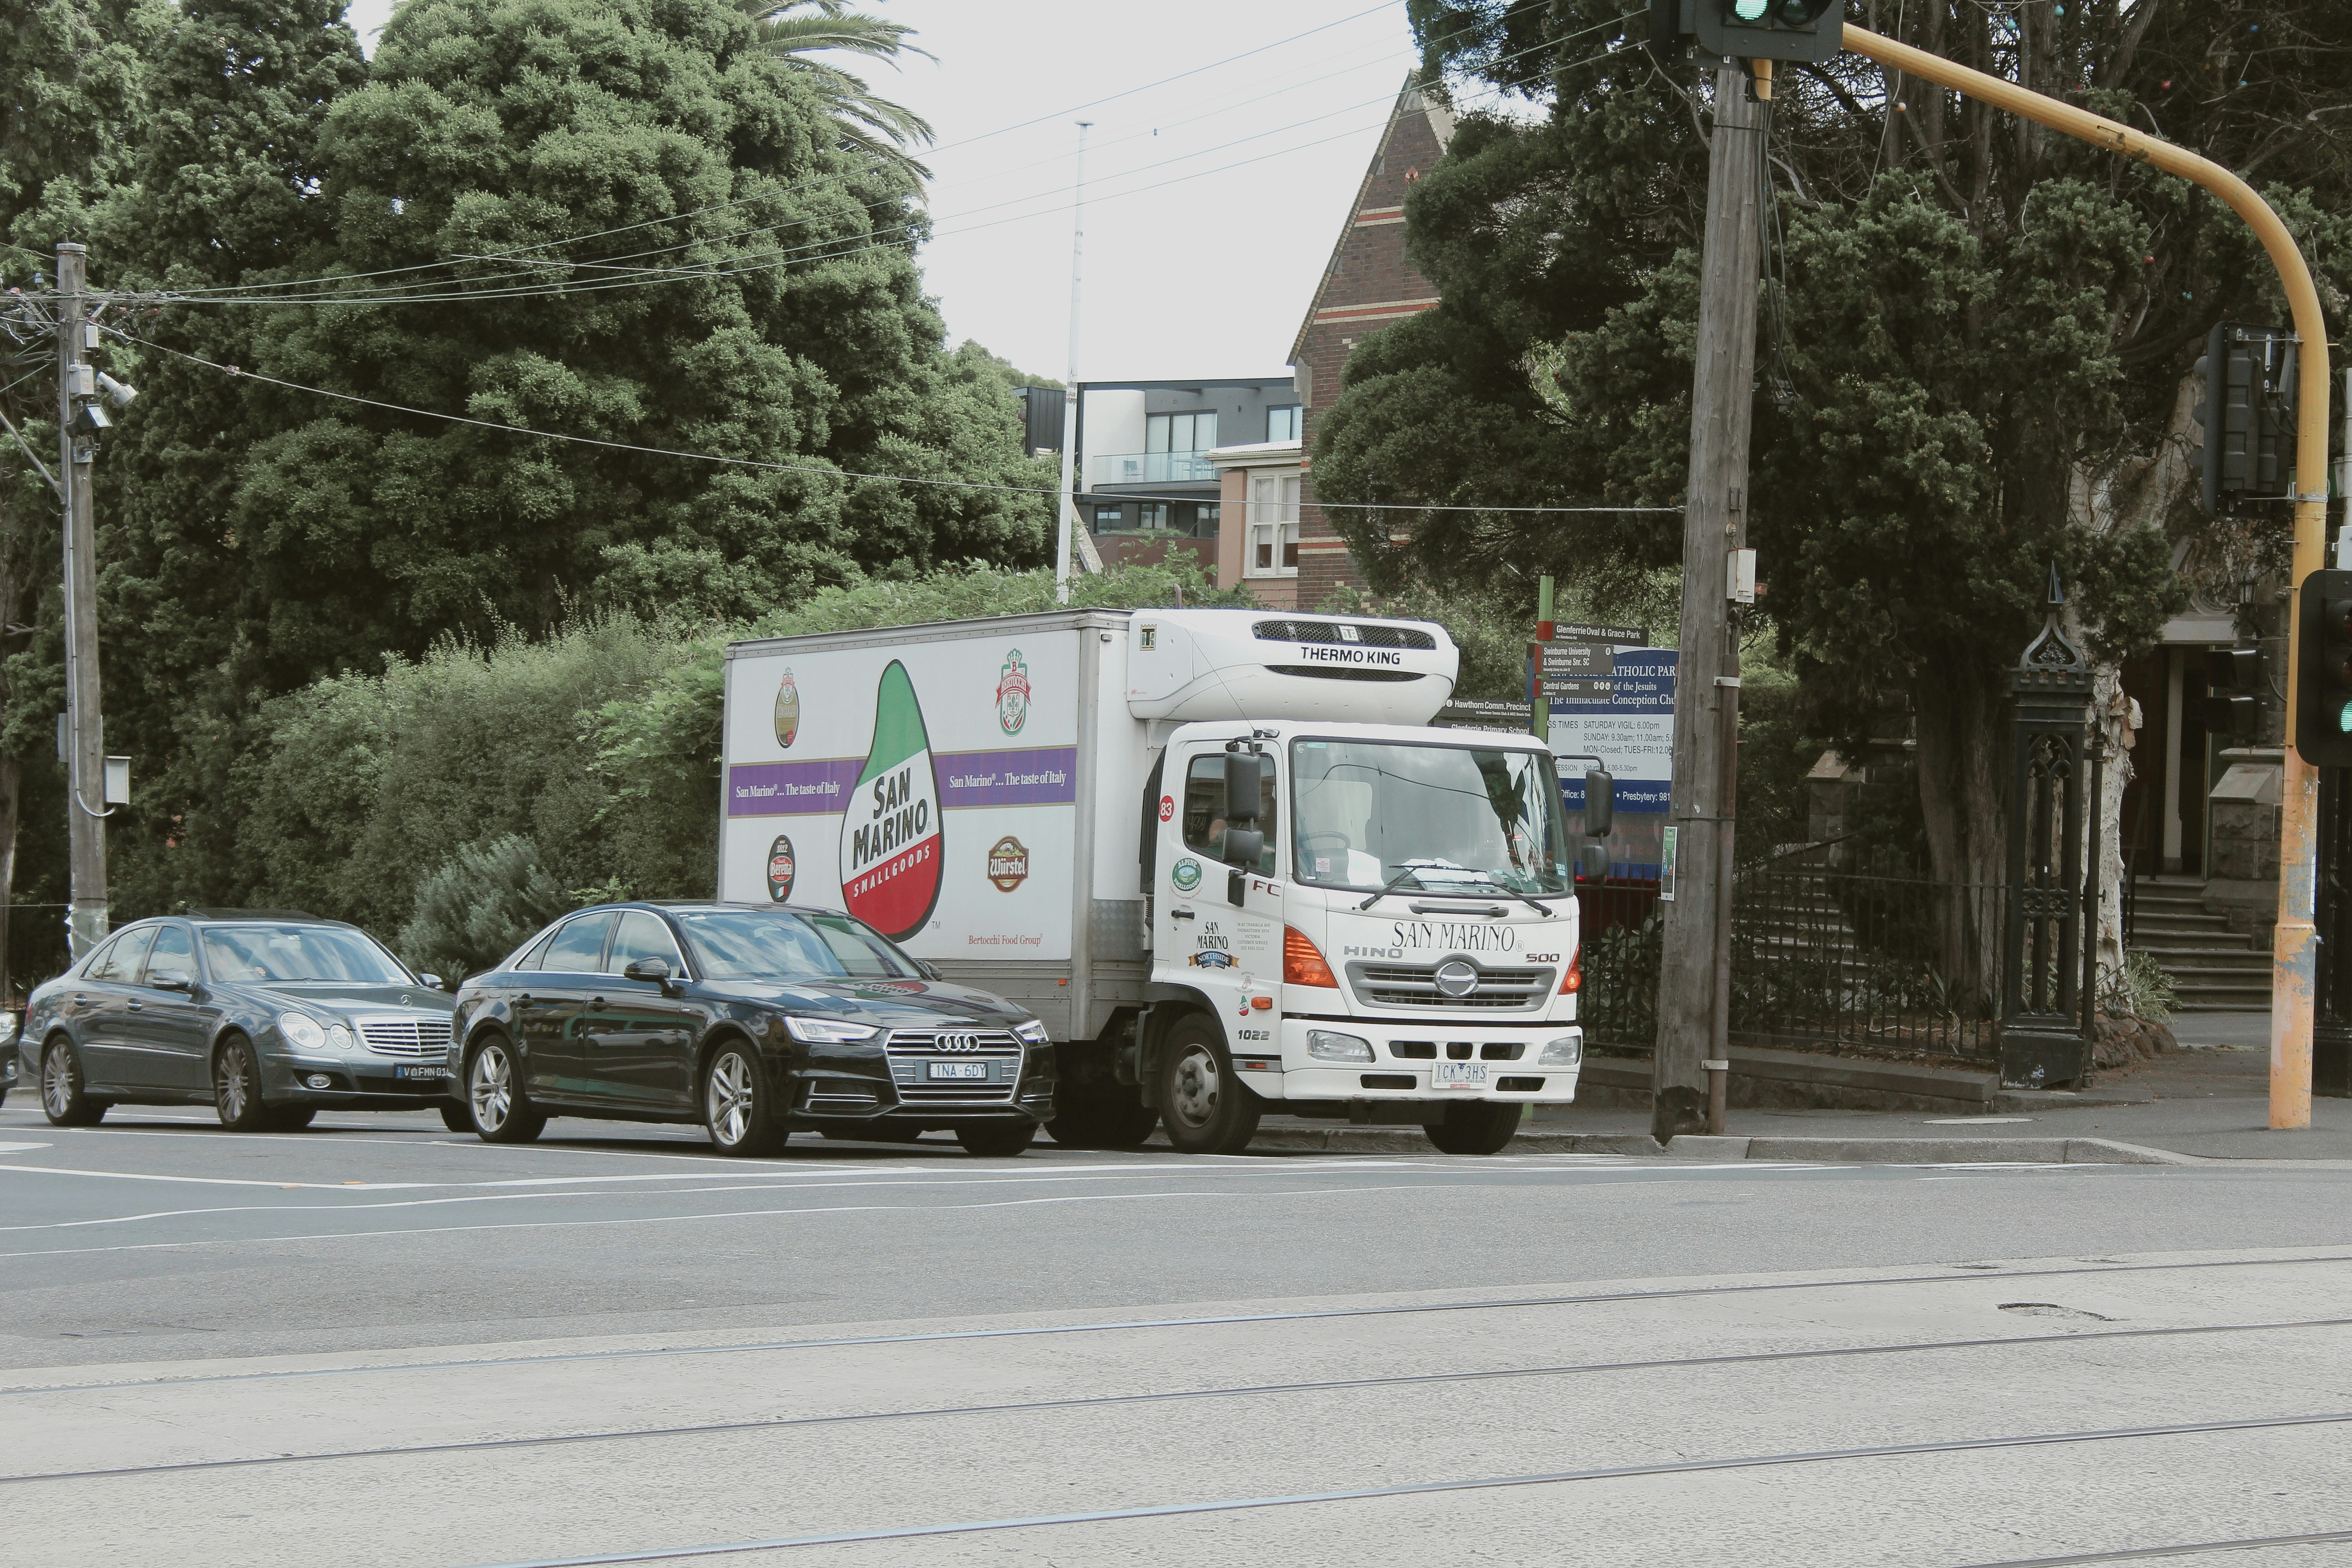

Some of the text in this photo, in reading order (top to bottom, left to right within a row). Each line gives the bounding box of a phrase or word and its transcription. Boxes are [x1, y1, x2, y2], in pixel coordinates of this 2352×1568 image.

[1556, 625, 1641, 639] Glenferrie Oval & Grace Park
[1301, 647, 1401, 665] THERMO KING
[1543, 647, 1591, 657] Swinburne University
[1012, 661, 1017, 672] B
[1548, 658, 1572, 666] Swinburne
[1573, 658, 1582, 666] Snr.
[1583, 658, 1590, 666] SC
[1608, 666, 1656, 676] ATHOLIC
[1001, 675, 1027, 691] BERTOCCHI
[1543, 681, 1579, 690] Central Gardens
[1614, 681, 1657, 693] of the Jesuits
[1455, 700, 1531, 711] Hawthorn Comm. Precinct
[1612, 694, 1657, 708] Conception
[778, 705, 797, 716] GOLD
[1509, 726, 1529, 735] School
[1558, 720, 1578, 729] TIMES
[1583, 721, 1660, 731] SATURDAY VIGIL: 6.00pm
[1583, 733, 1610, 741] SUNDAY:
[1611, 733, 1635, 742] 9.30am;
[1637, 734, 1664, 743] 11.00am;
[1583, 745, 1622, 754] MON-Closed;
[1607, 764, 1637, 773] 5.00-5.30pm
[950, 775, 964, 788] San
[1005, 772, 1020, 786] The
[1021, 773, 1039, 785] taste
[1040, 770, 1049, 784] of
[1049, 769, 1067, 787] Italy
[736, 786, 749, 798] San
[785, 783, 799, 795] The
[800, 784, 816, 795] taste
[817, 781, 824, 794] of
[825, 780, 840, 797] Italy
[873, 767, 911, 819] SAN
[1623, 791, 1670, 803] Presbytery: 981
[1160, 802, 1172, 817] 83
[776, 844, 788, 853] 1812
[769, 862, 792, 877] Beretta
[990, 857, 1026, 877] Würstel
[1178, 859, 1198, 869] ALPINE
[854, 844, 930, 898] SMALLGOODS
[1174, 877, 1200, 890] SMALLGOODS
[1253, 880, 1281, 897] FC
[932, 921, 941, 930] TM
[1205, 921, 1220, 935] SAN
[969, 934, 1000, 945] Bertocchi
[1002, 934, 1018, 945] Food
[1392, 921, 1433, 948] SAN
[1196, 936, 1228, 950] MARINO
[1197, 952, 1230, 964] NORTHSIDE
[1344, 945, 1403, 959] HINO
[1525, 953, 1560, 963] 500
[1238, 1029, 1270, 1040] 1022
[1437, 1064, 1486, 1079] 1CK 3HS
